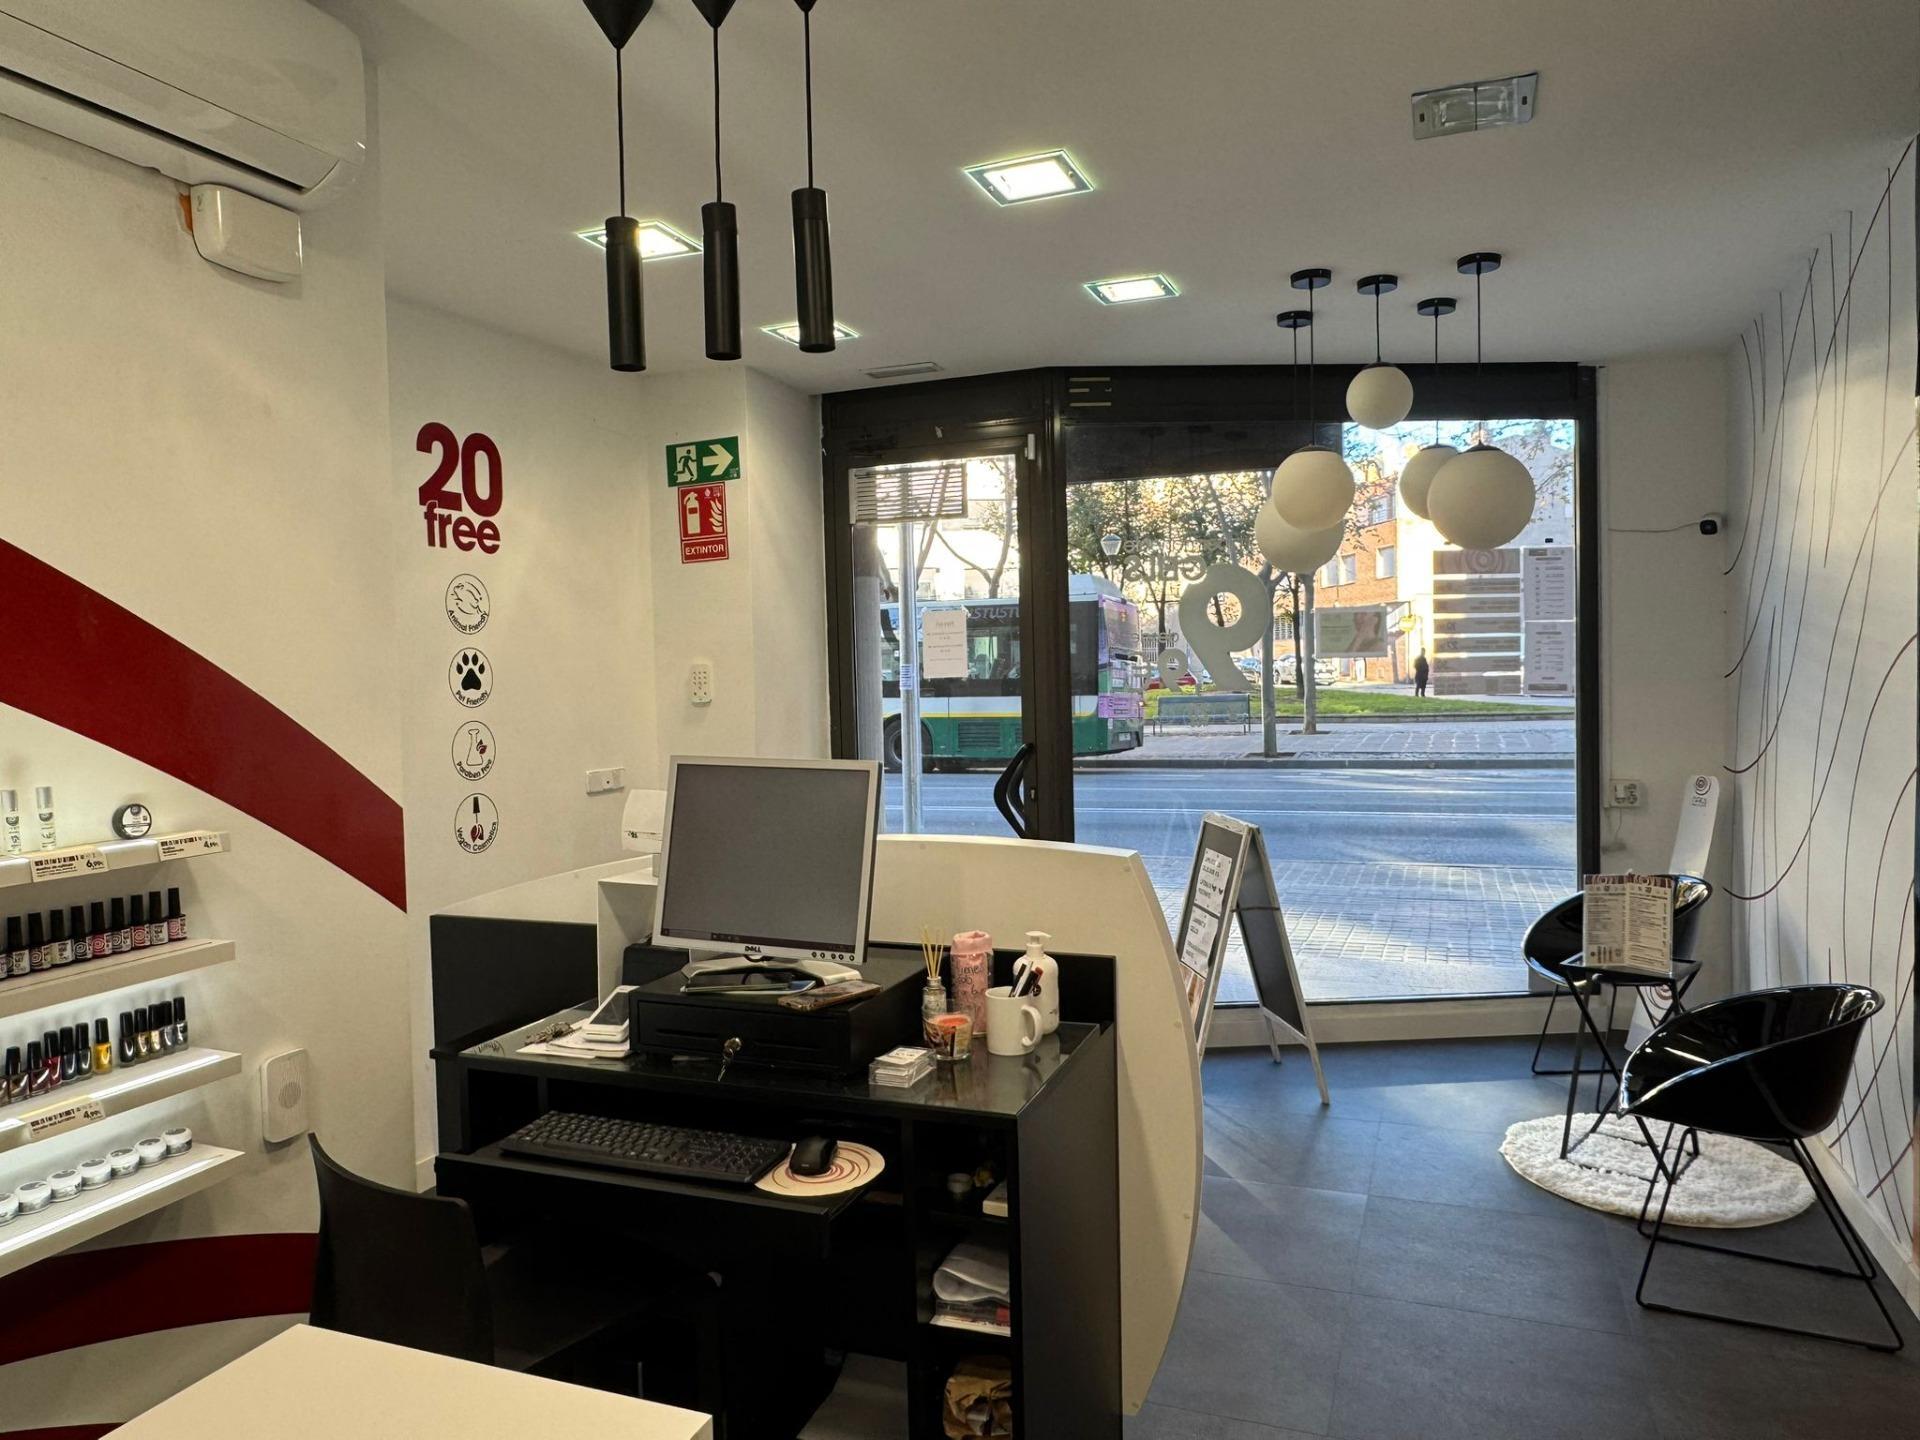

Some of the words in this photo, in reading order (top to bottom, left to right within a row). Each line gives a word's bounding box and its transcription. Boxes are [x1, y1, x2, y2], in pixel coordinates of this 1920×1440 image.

[416, 421, 503, 518] 20
[423, 500, 502, 554] free
[685, 543, 725, 556] EXTINTOR
[448, 608, 468, 632] Animal
[455, 689, 466, 703] Pet
[466, 689, 489, 705] Friendly
[456, 760, 481, 779] Paraben
[456, 826, 472, 850] Vegan
[745, 945, 761, 953] DELL
